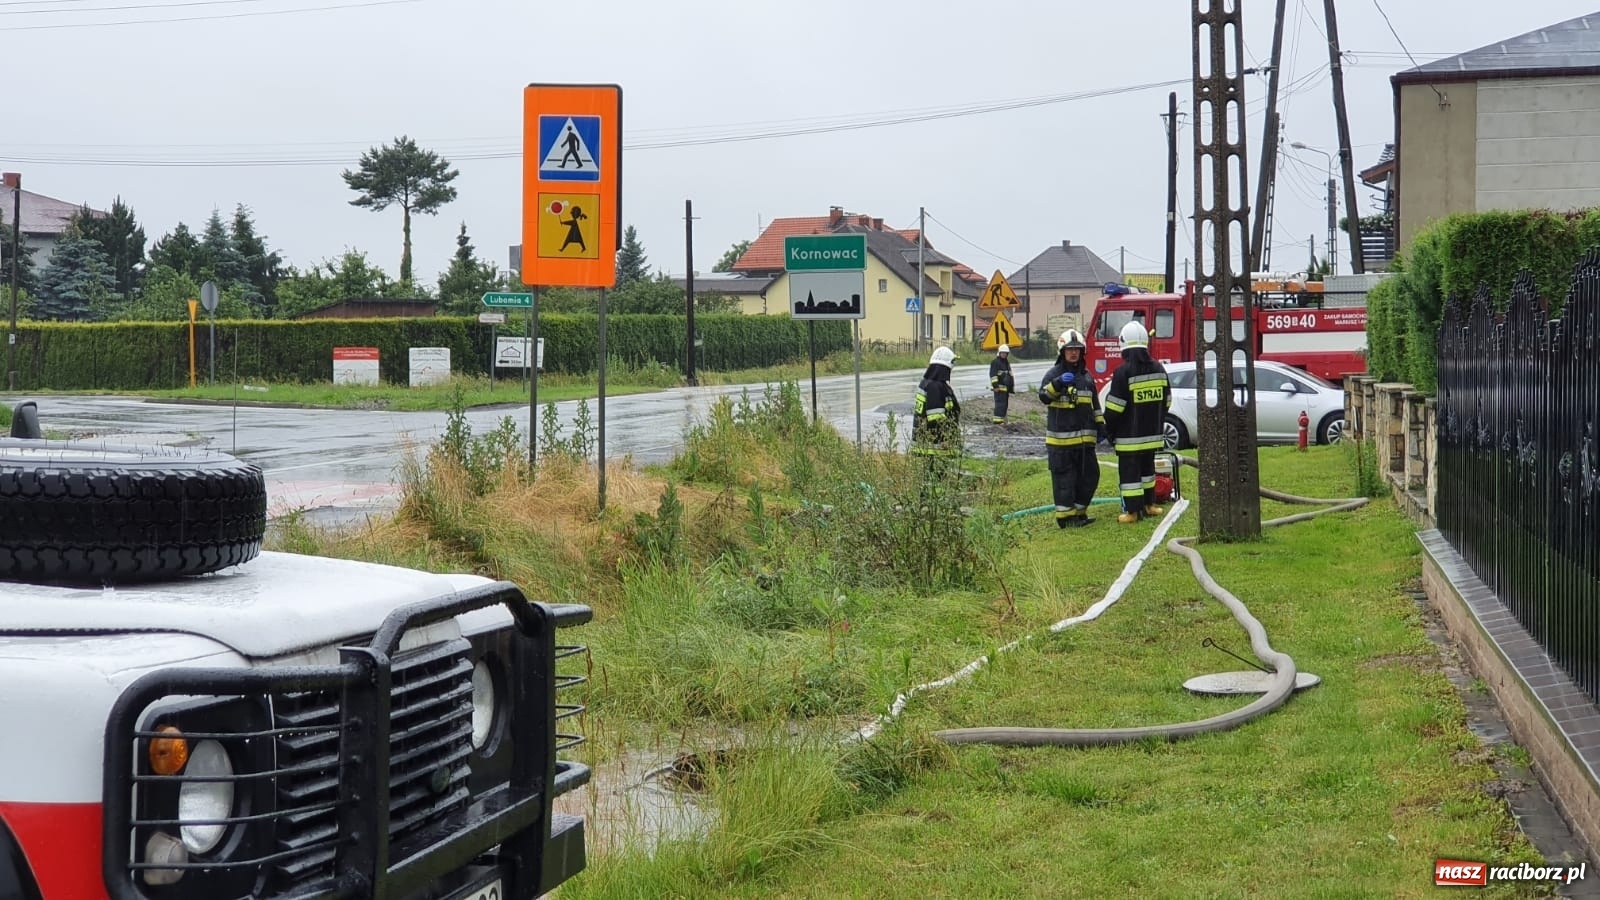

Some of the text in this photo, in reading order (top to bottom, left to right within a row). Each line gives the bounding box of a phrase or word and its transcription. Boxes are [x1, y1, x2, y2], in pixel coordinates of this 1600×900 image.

[791, 247, 858, 260] Kornowac
[490, 295, 530, 304] Lubomia 4
[1267, 315, 1291, 329] 569
[1299, 314, 1316, 328] 40
